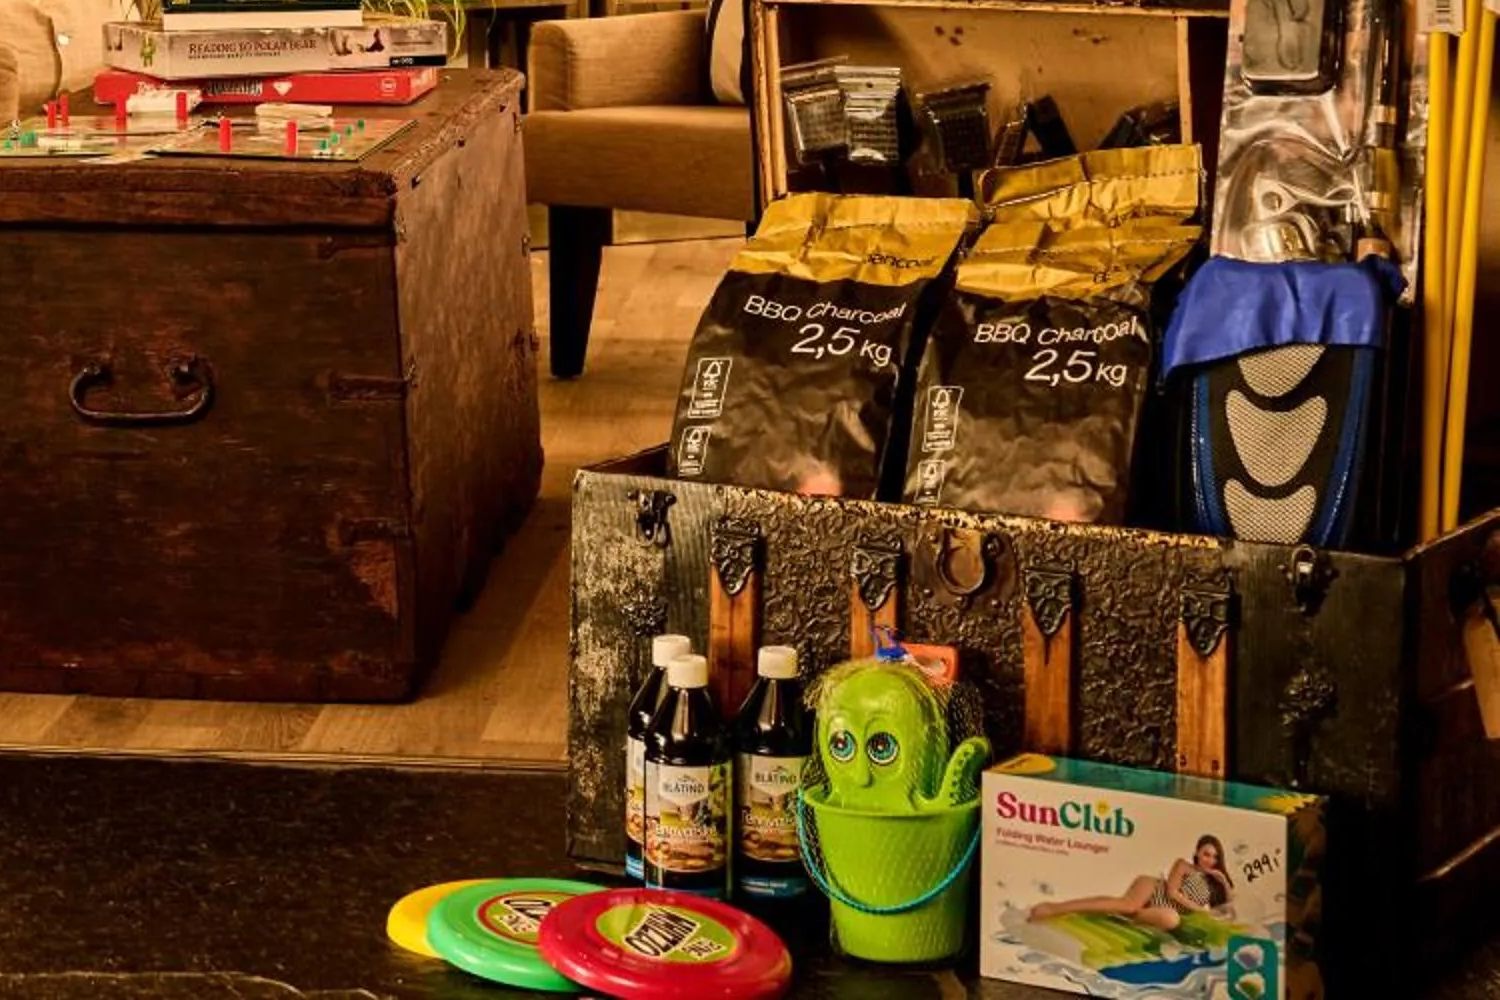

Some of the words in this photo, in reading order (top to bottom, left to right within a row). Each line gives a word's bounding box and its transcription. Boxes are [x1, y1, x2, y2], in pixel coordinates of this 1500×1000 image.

[254, 41, 287, 51] POLAR
[743, 295, 801, 322] BBQ
[806, 302, 907, 325] Charcoal
[791, 323, 860, 359] 2,5
[860, 340, 893, 367] kg
[974, 323, 1031, 344] BBQ
[1037, 315, 1138, 345] Charcoal
[1024, 349, 1096, 387] 2,5
[1095, 363, 1128, 387] kg
[997, 792, 1135, 837] SunClub
[996, 827, 1033, 843] Folding
[1036, 835, 1064, 846] Water
[1068, 838, 1109, 854] Lounger
